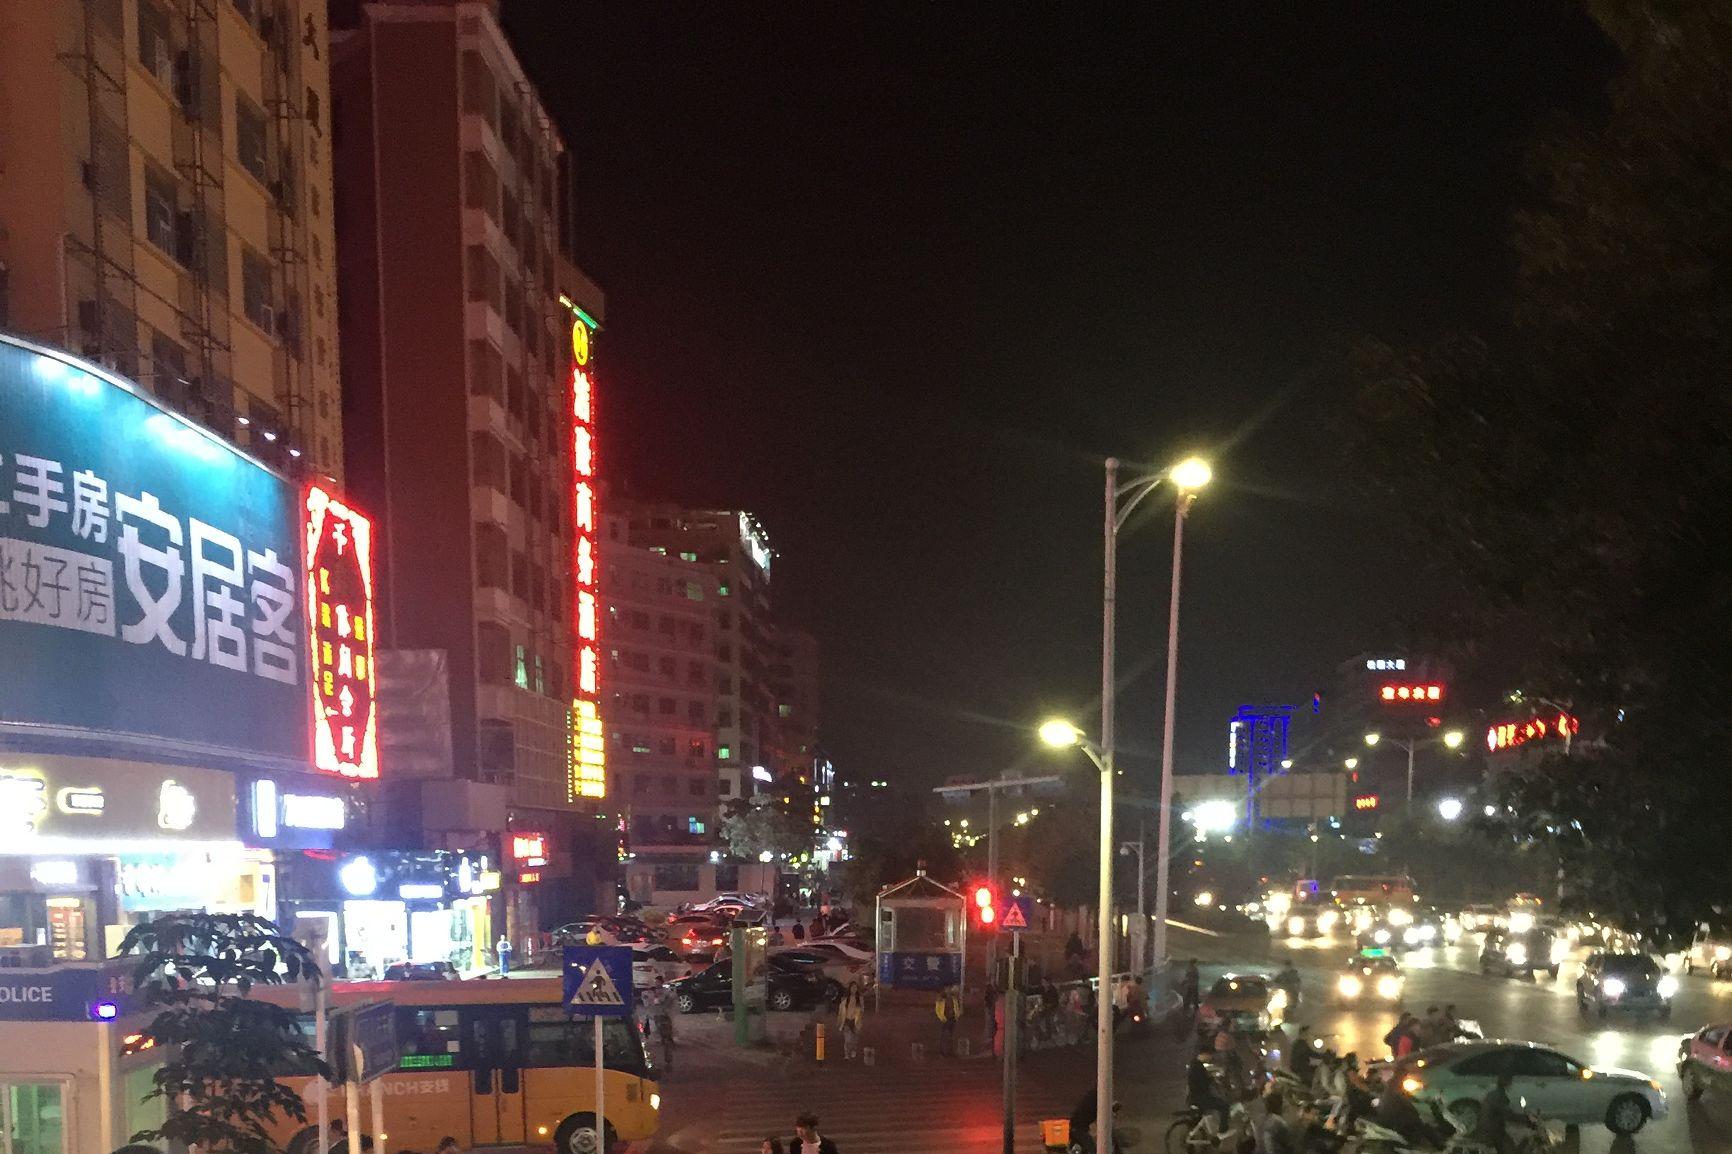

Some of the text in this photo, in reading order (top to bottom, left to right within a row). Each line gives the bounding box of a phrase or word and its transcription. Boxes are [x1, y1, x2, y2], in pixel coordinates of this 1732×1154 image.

[0, 453, 110, 545] 手房
[116, 491, 298, 685] 安居客
[0, 986, 53, 1003] OLICE
